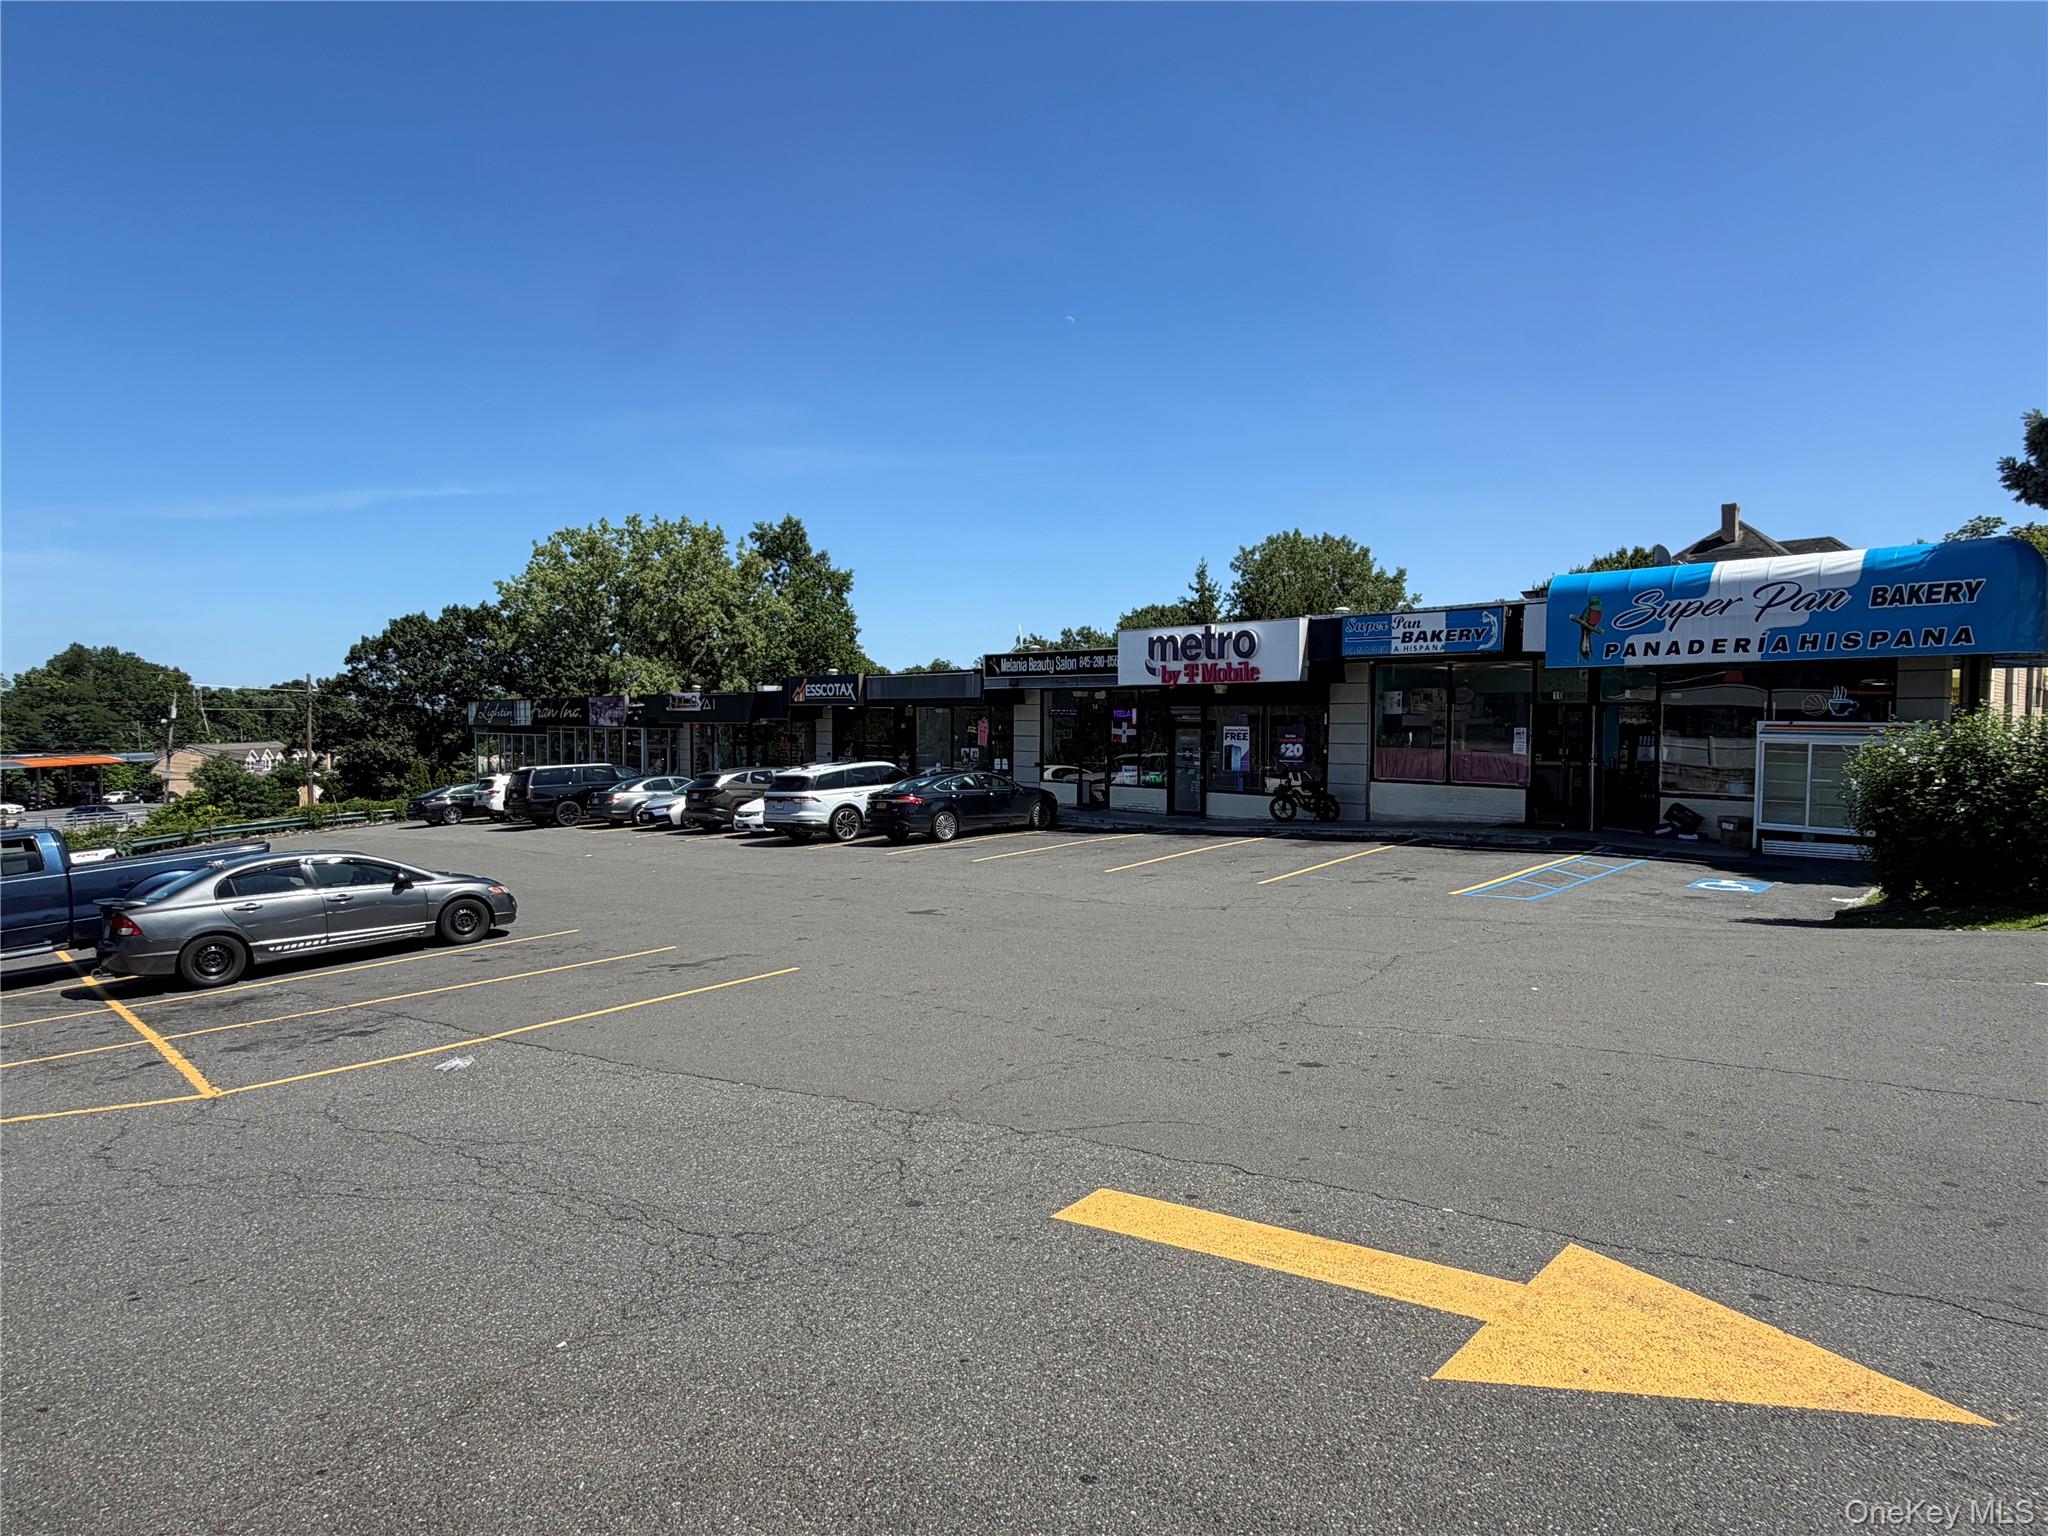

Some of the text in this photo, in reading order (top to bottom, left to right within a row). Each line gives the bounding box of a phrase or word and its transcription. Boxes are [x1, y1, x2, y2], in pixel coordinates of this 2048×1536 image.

[1611, 578, 1986, 632] Super Pan BAKERY
[1345, 615, 1422, 636] Super Pan
[1400, 626, 1489, 644] BAKERY
[1148, 625, 1258, 661] metro
[1402, 642, 1446, 653] HISPANA
[1796, 625, 1976, 654] HISPANA
[1001, 657, 1027, 673] Melania
[1028, 656, 1054, 674] Beauty
[1055, 655, 1077, 670] Salon
[1161, 664, 1182, 689] by
[559, 700, 583, 719] Inc.
[1224, 732, 1249, 741] FREE
[1279, 743, 1304, 757] $20
